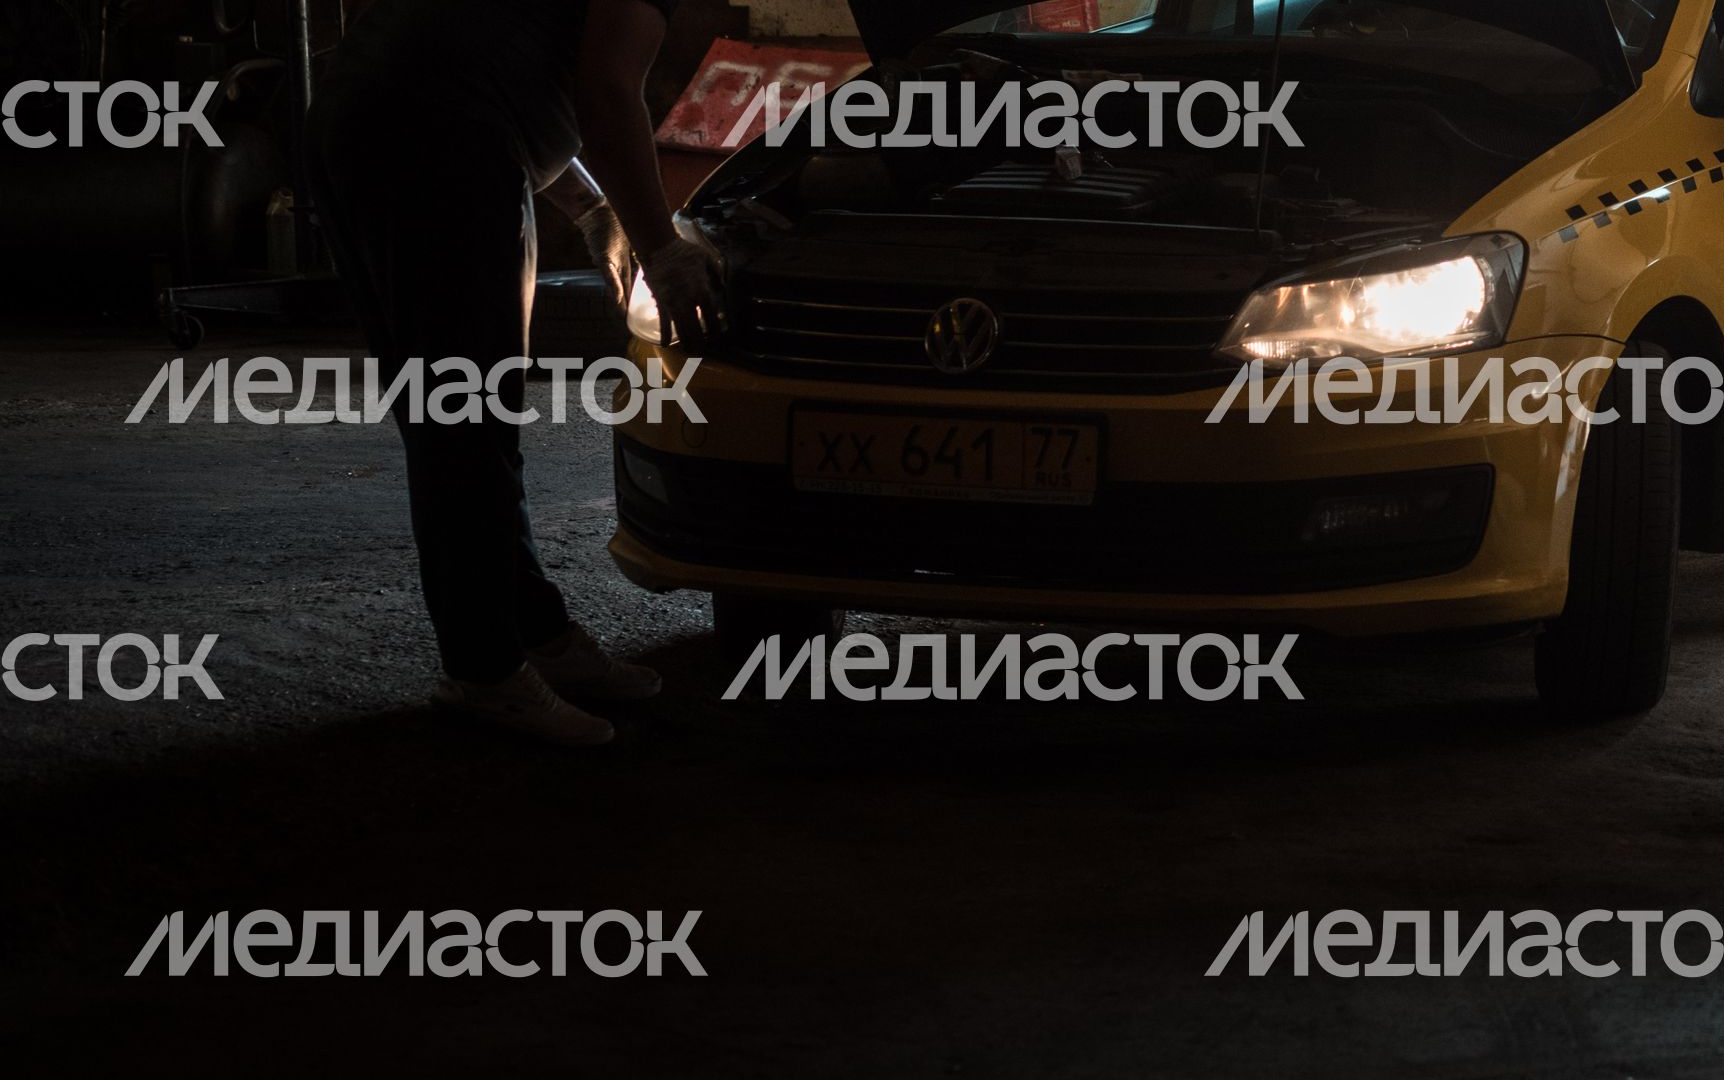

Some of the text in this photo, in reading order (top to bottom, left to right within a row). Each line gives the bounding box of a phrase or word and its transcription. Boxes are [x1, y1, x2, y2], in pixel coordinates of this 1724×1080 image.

[900, 423, 995, 482] 641
[1031, 426, 1080, 473] 77
[1035, 472, 1073, 489] RUS
